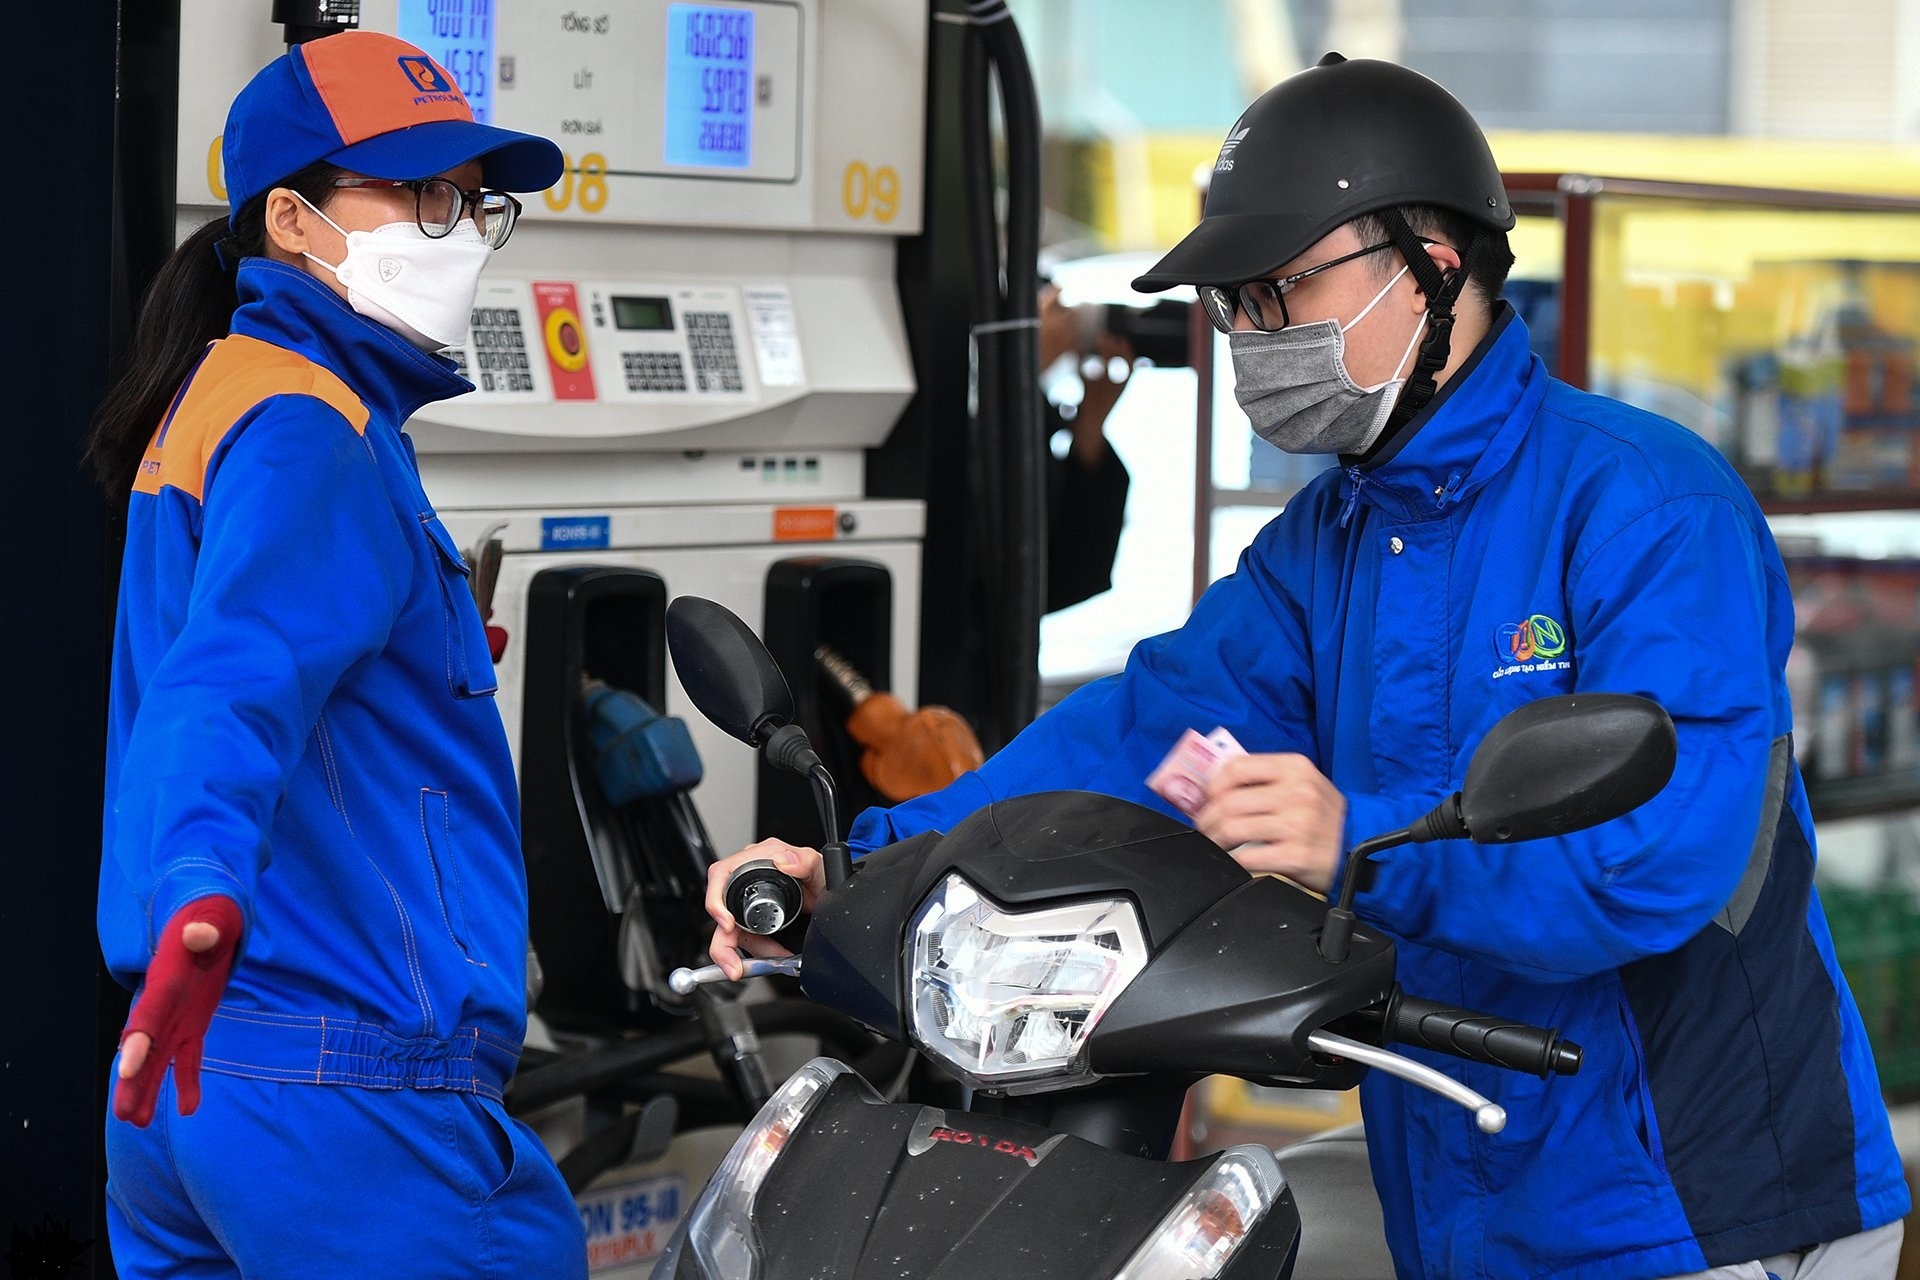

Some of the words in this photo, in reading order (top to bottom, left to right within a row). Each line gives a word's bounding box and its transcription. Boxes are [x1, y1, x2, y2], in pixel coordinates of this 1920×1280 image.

[543, 151, 609, 215] 08
[843, 159, 902, 225] 09
[579, 1200, 614, 1238] ON
